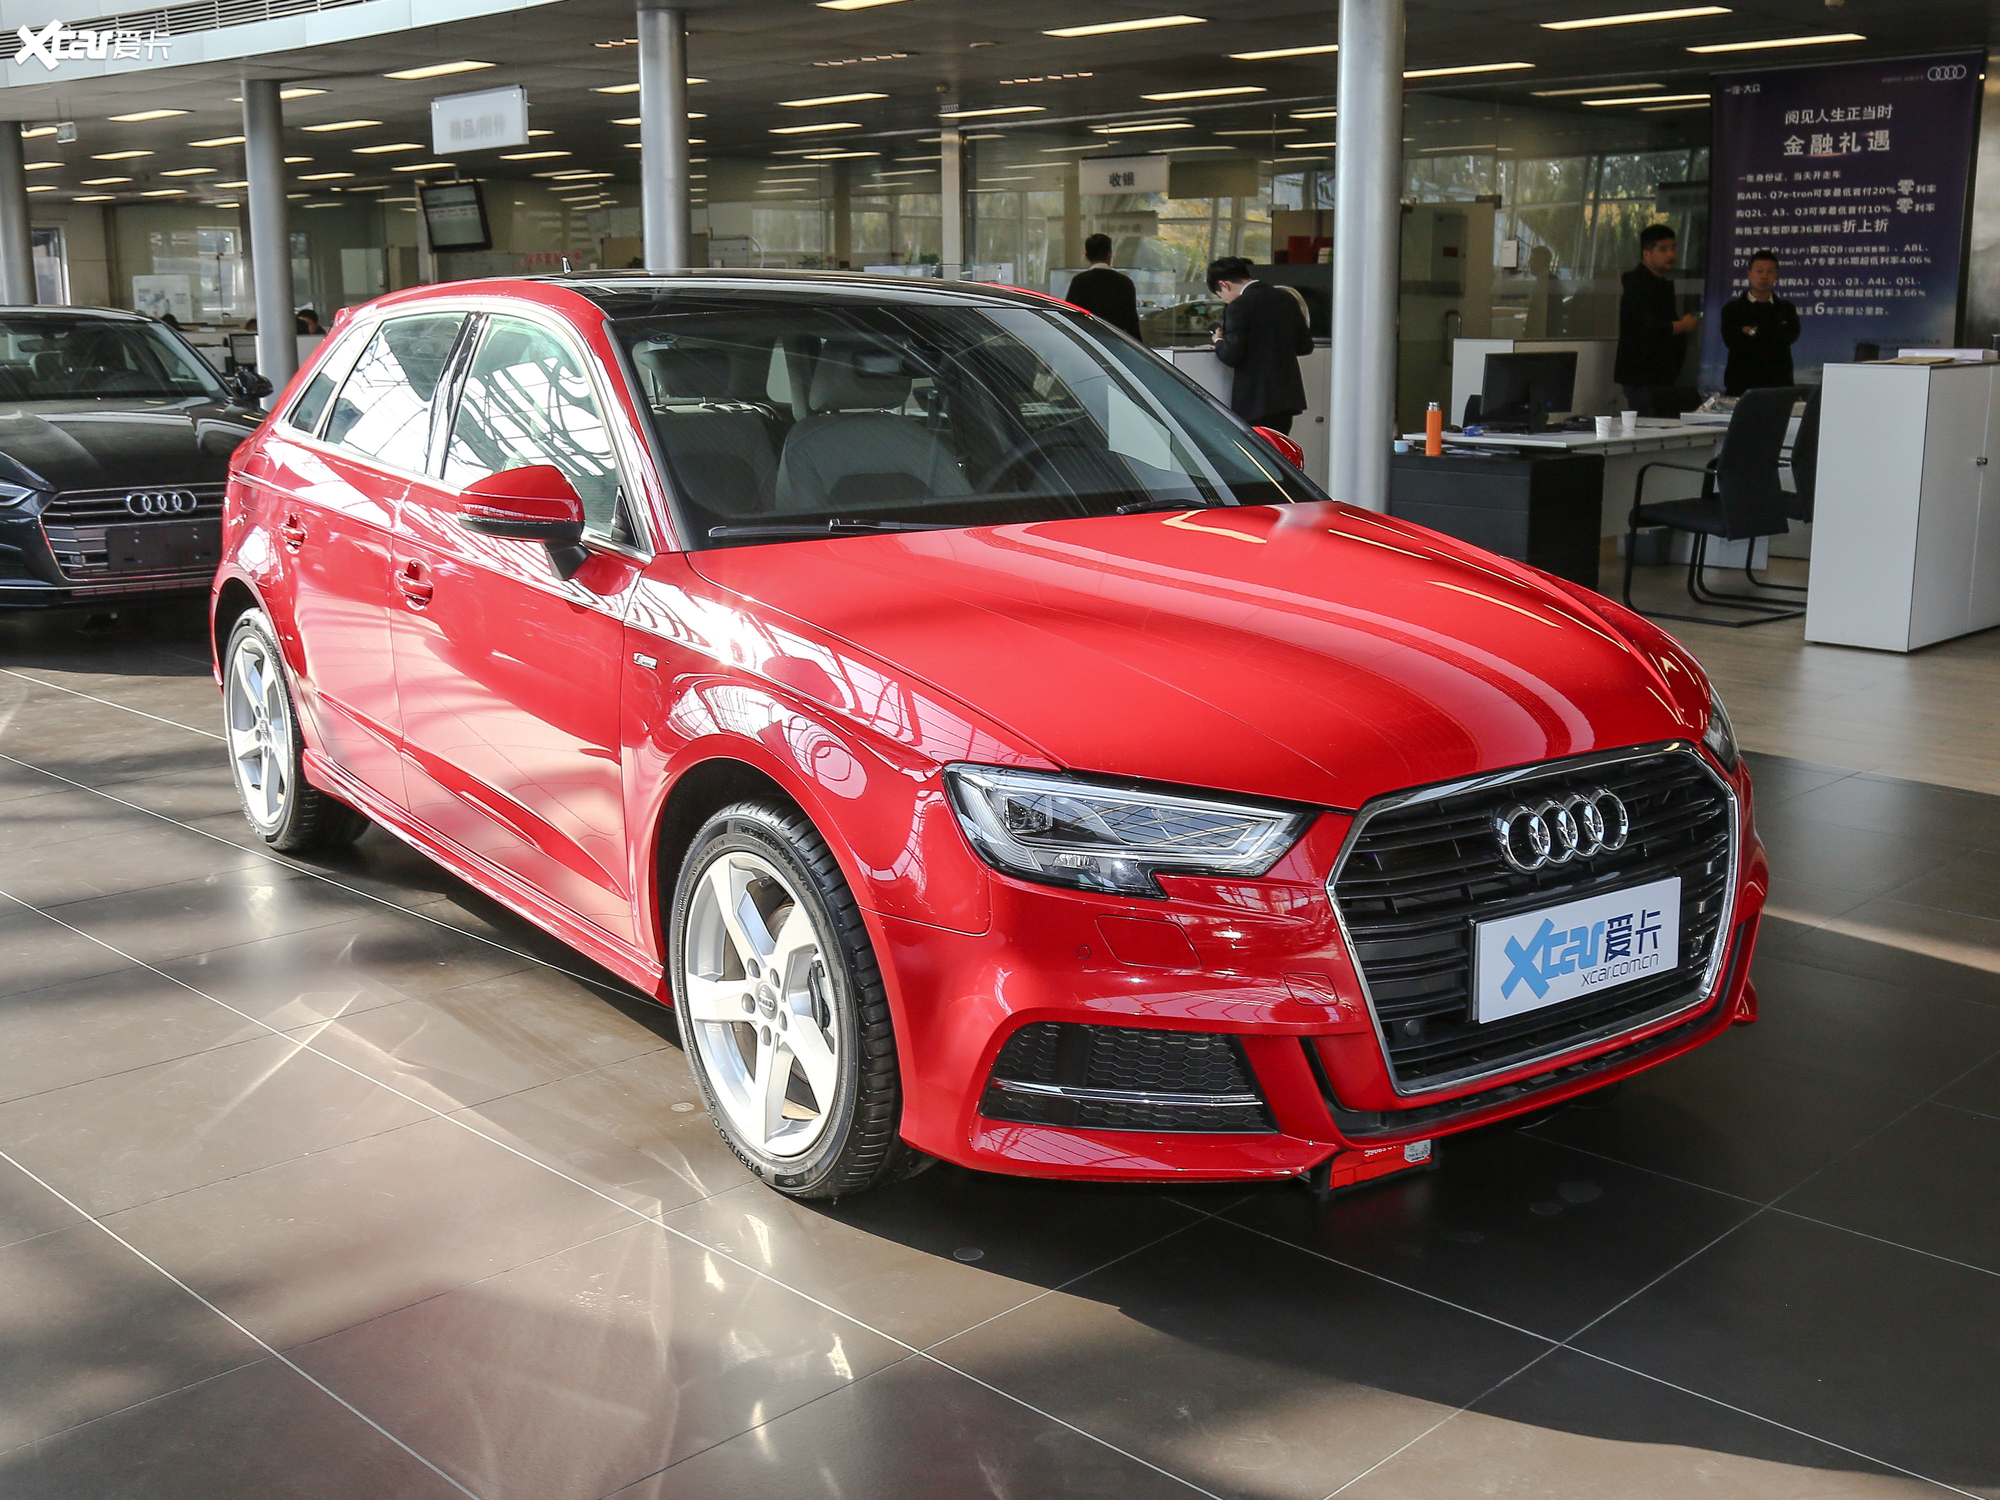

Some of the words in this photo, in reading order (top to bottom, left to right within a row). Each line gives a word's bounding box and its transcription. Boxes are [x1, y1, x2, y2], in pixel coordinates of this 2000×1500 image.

[1785, 104, 1893, 125] 阅见人生正当时
[1783, 130, 1890, 156] 金融礼遇
[1109, 172, 1135, 187] 收银
[1581, 953, 1659, 988] xcar.com.cn
